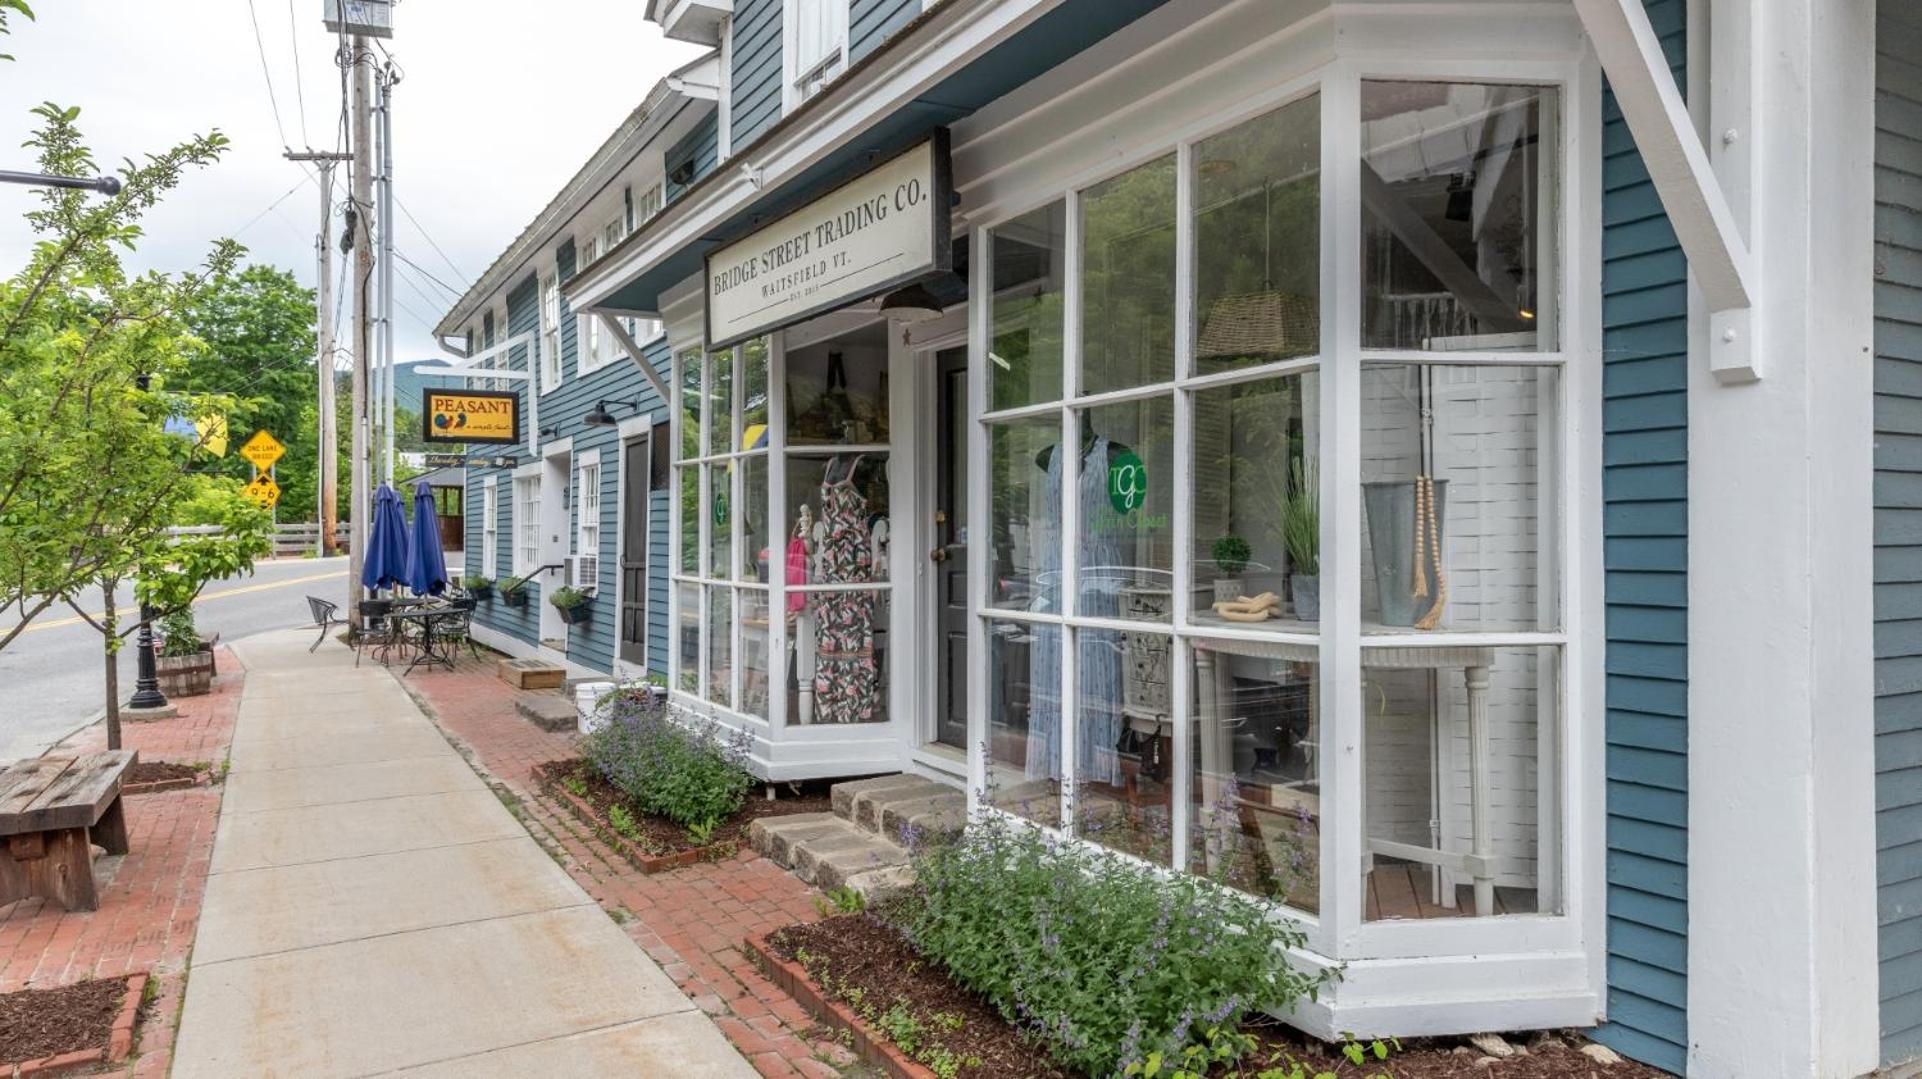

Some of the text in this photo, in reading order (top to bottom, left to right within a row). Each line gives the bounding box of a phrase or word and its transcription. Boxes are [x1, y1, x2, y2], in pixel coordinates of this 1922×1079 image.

[714, 178, 927, 295] BRIDGE STREET TRADING CO.
[761, 251, 851, 298] WAITSFIELD VT.
[434, 399, 511, 414] PEASANT
